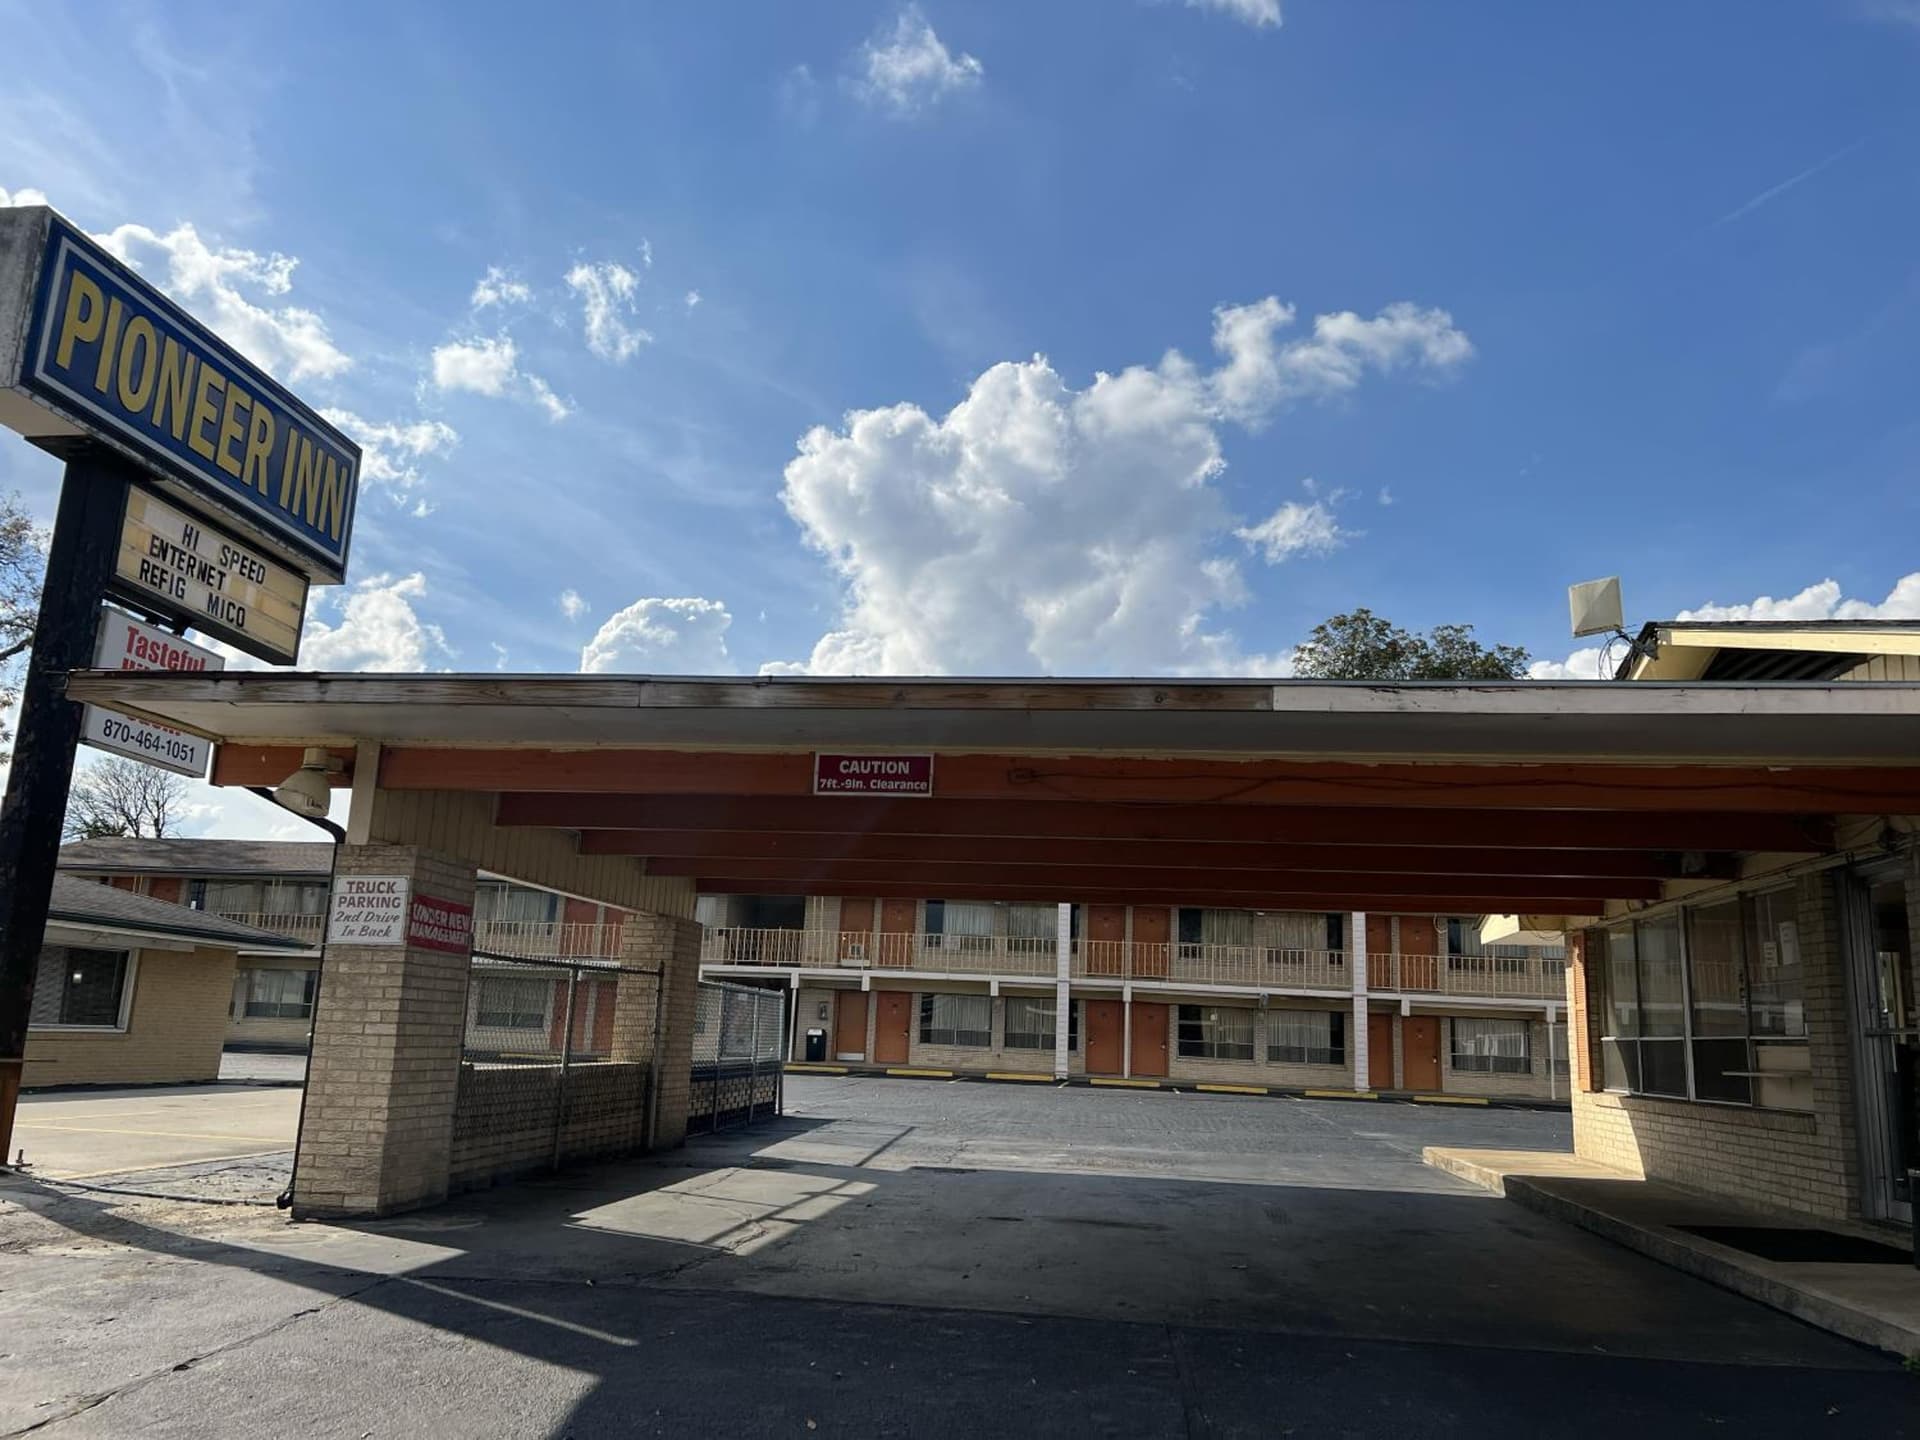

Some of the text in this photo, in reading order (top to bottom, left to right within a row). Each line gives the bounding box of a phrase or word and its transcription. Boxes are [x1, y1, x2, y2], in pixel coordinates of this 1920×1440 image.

[56, 270, 347, 542] PIONEER INN
[149, 534, 226, 591] ENTERNET
[182, 523, 266, 585] HI SPEED
[139, 557, 245, 628] REFIG MICO
[125, 625, 206, 671] Tasteful
[103, 719, 195, 763] 870-464-1051
[839, 759, 910, 774] CAUTION
[869, 779, 928, 790] Clearance
[346, 881, 397, 894] TRUCK
[338, 895, 401, 909] PARKING
[334, 910, 401, 923] 2nd Drive
[413, 903, 449, 927] UNDER
[340, 924, 393, 938] In Back
[410, 921, 470, 945] MANAGEMENT
